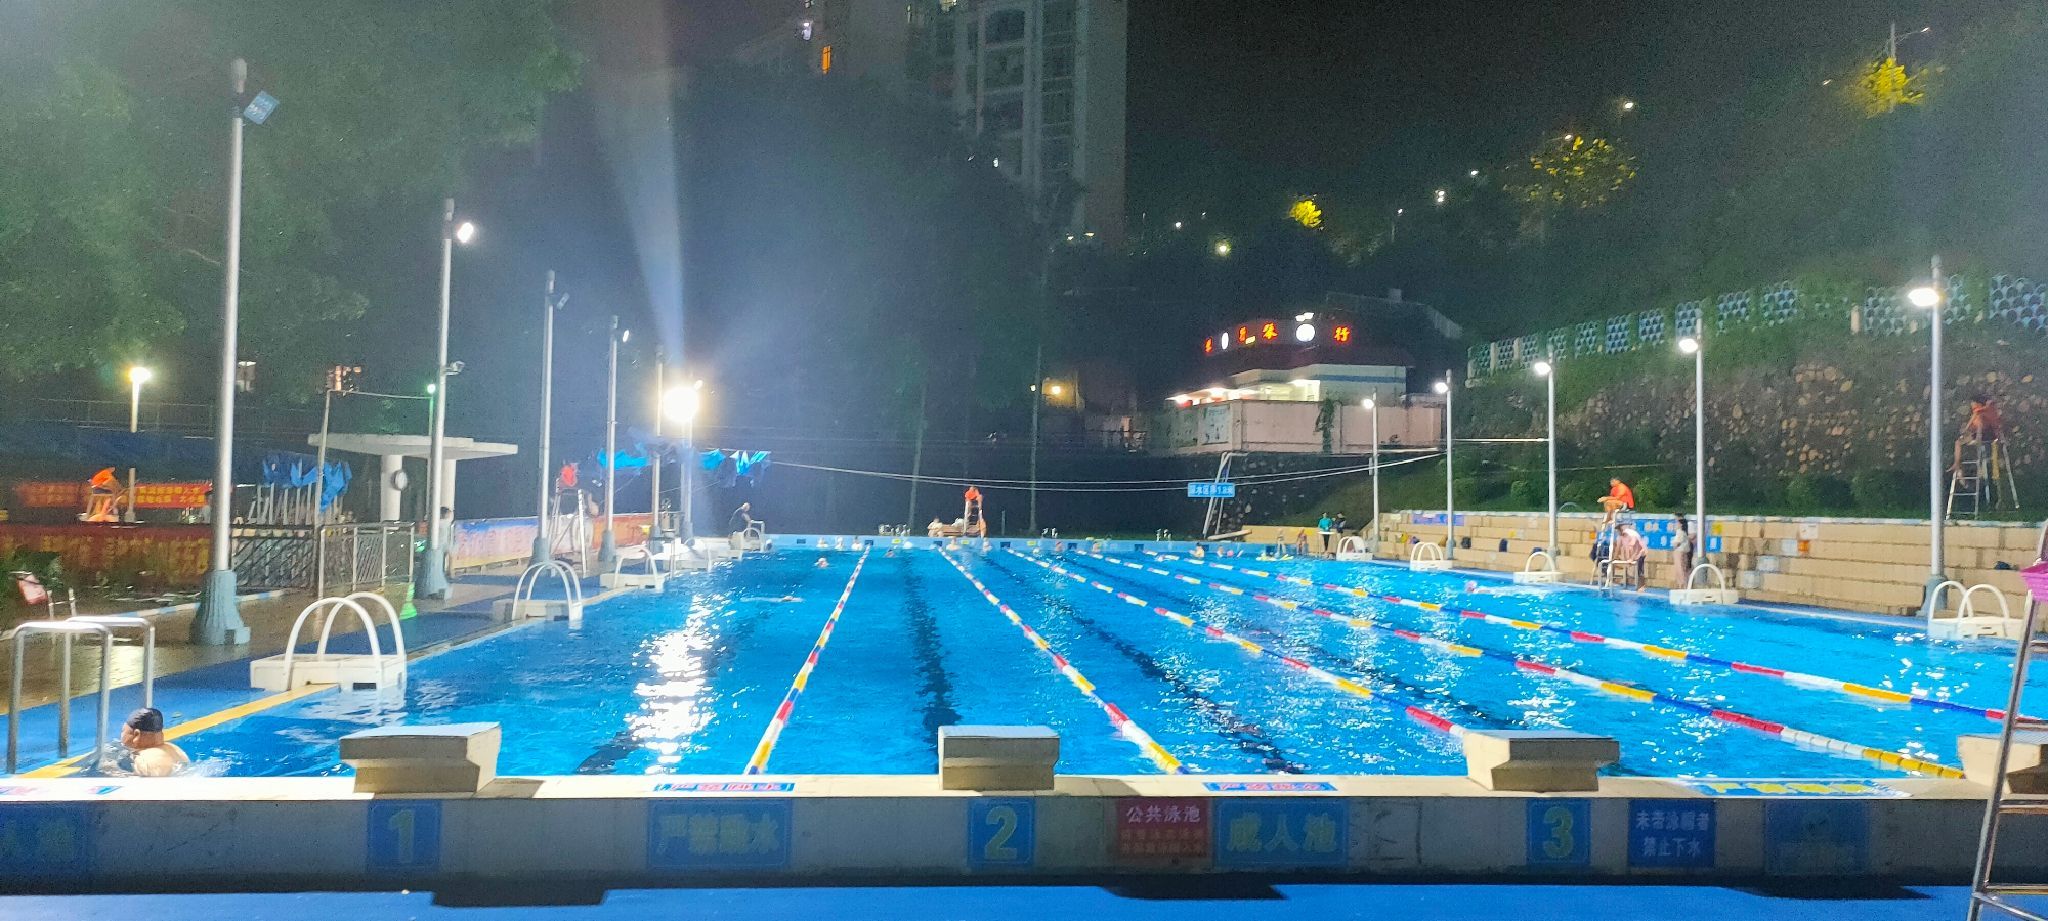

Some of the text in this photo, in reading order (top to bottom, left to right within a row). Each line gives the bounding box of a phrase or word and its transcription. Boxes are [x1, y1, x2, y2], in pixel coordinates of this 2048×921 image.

[388, 809, 415, 864] 1
[984, 805, 1018, 859] 2
[1126, 805, 1201, 824] 公共泳池
[1226, 812, 1338, 853] 成人池
[1543, 806, 1574, 858] 3
[1643, 836, 1702, 858] 禁止下水
